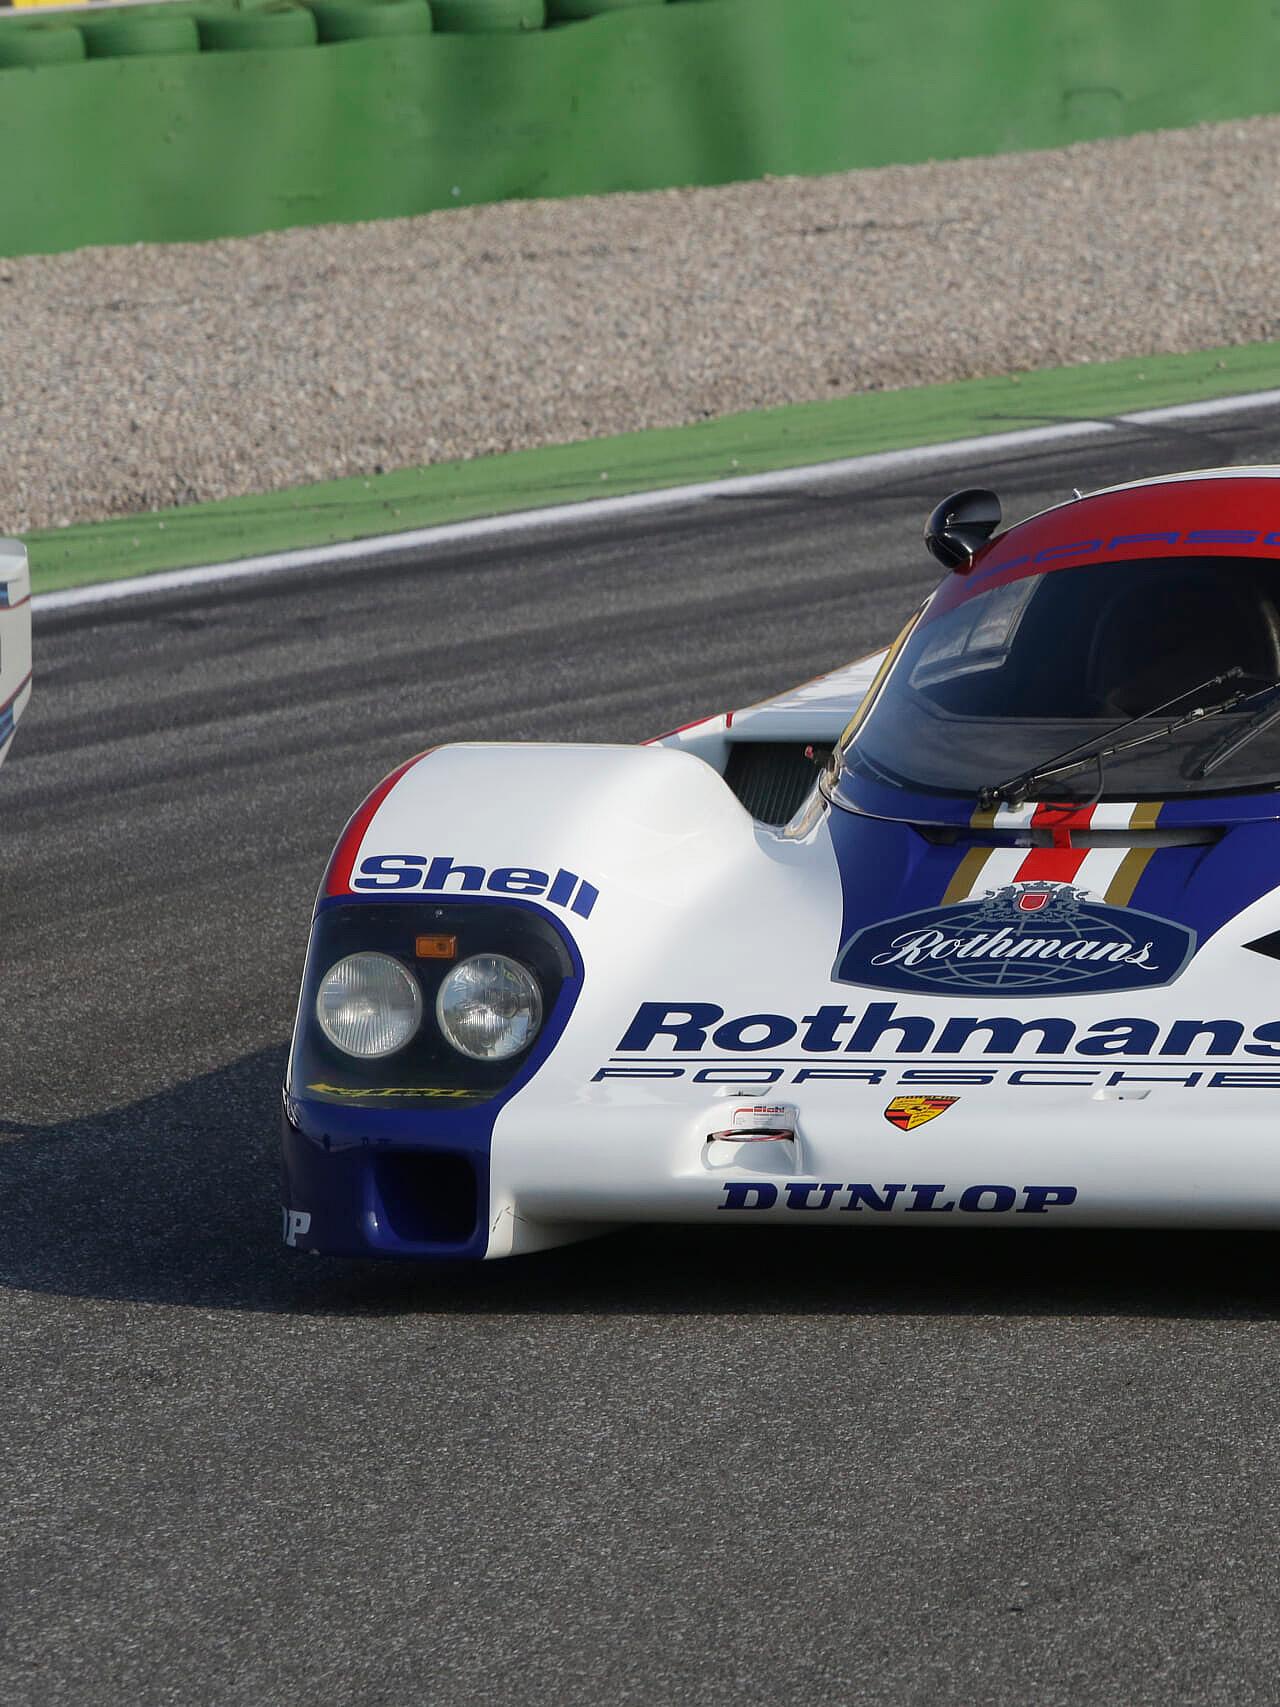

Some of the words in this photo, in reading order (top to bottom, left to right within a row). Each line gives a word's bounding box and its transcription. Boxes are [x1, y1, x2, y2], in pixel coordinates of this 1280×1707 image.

[353, 854, 599, 919] Shell
[871, 928, 1159, 970] Rothmans
[718, 1182, 1077, 1214] DUNLOP
